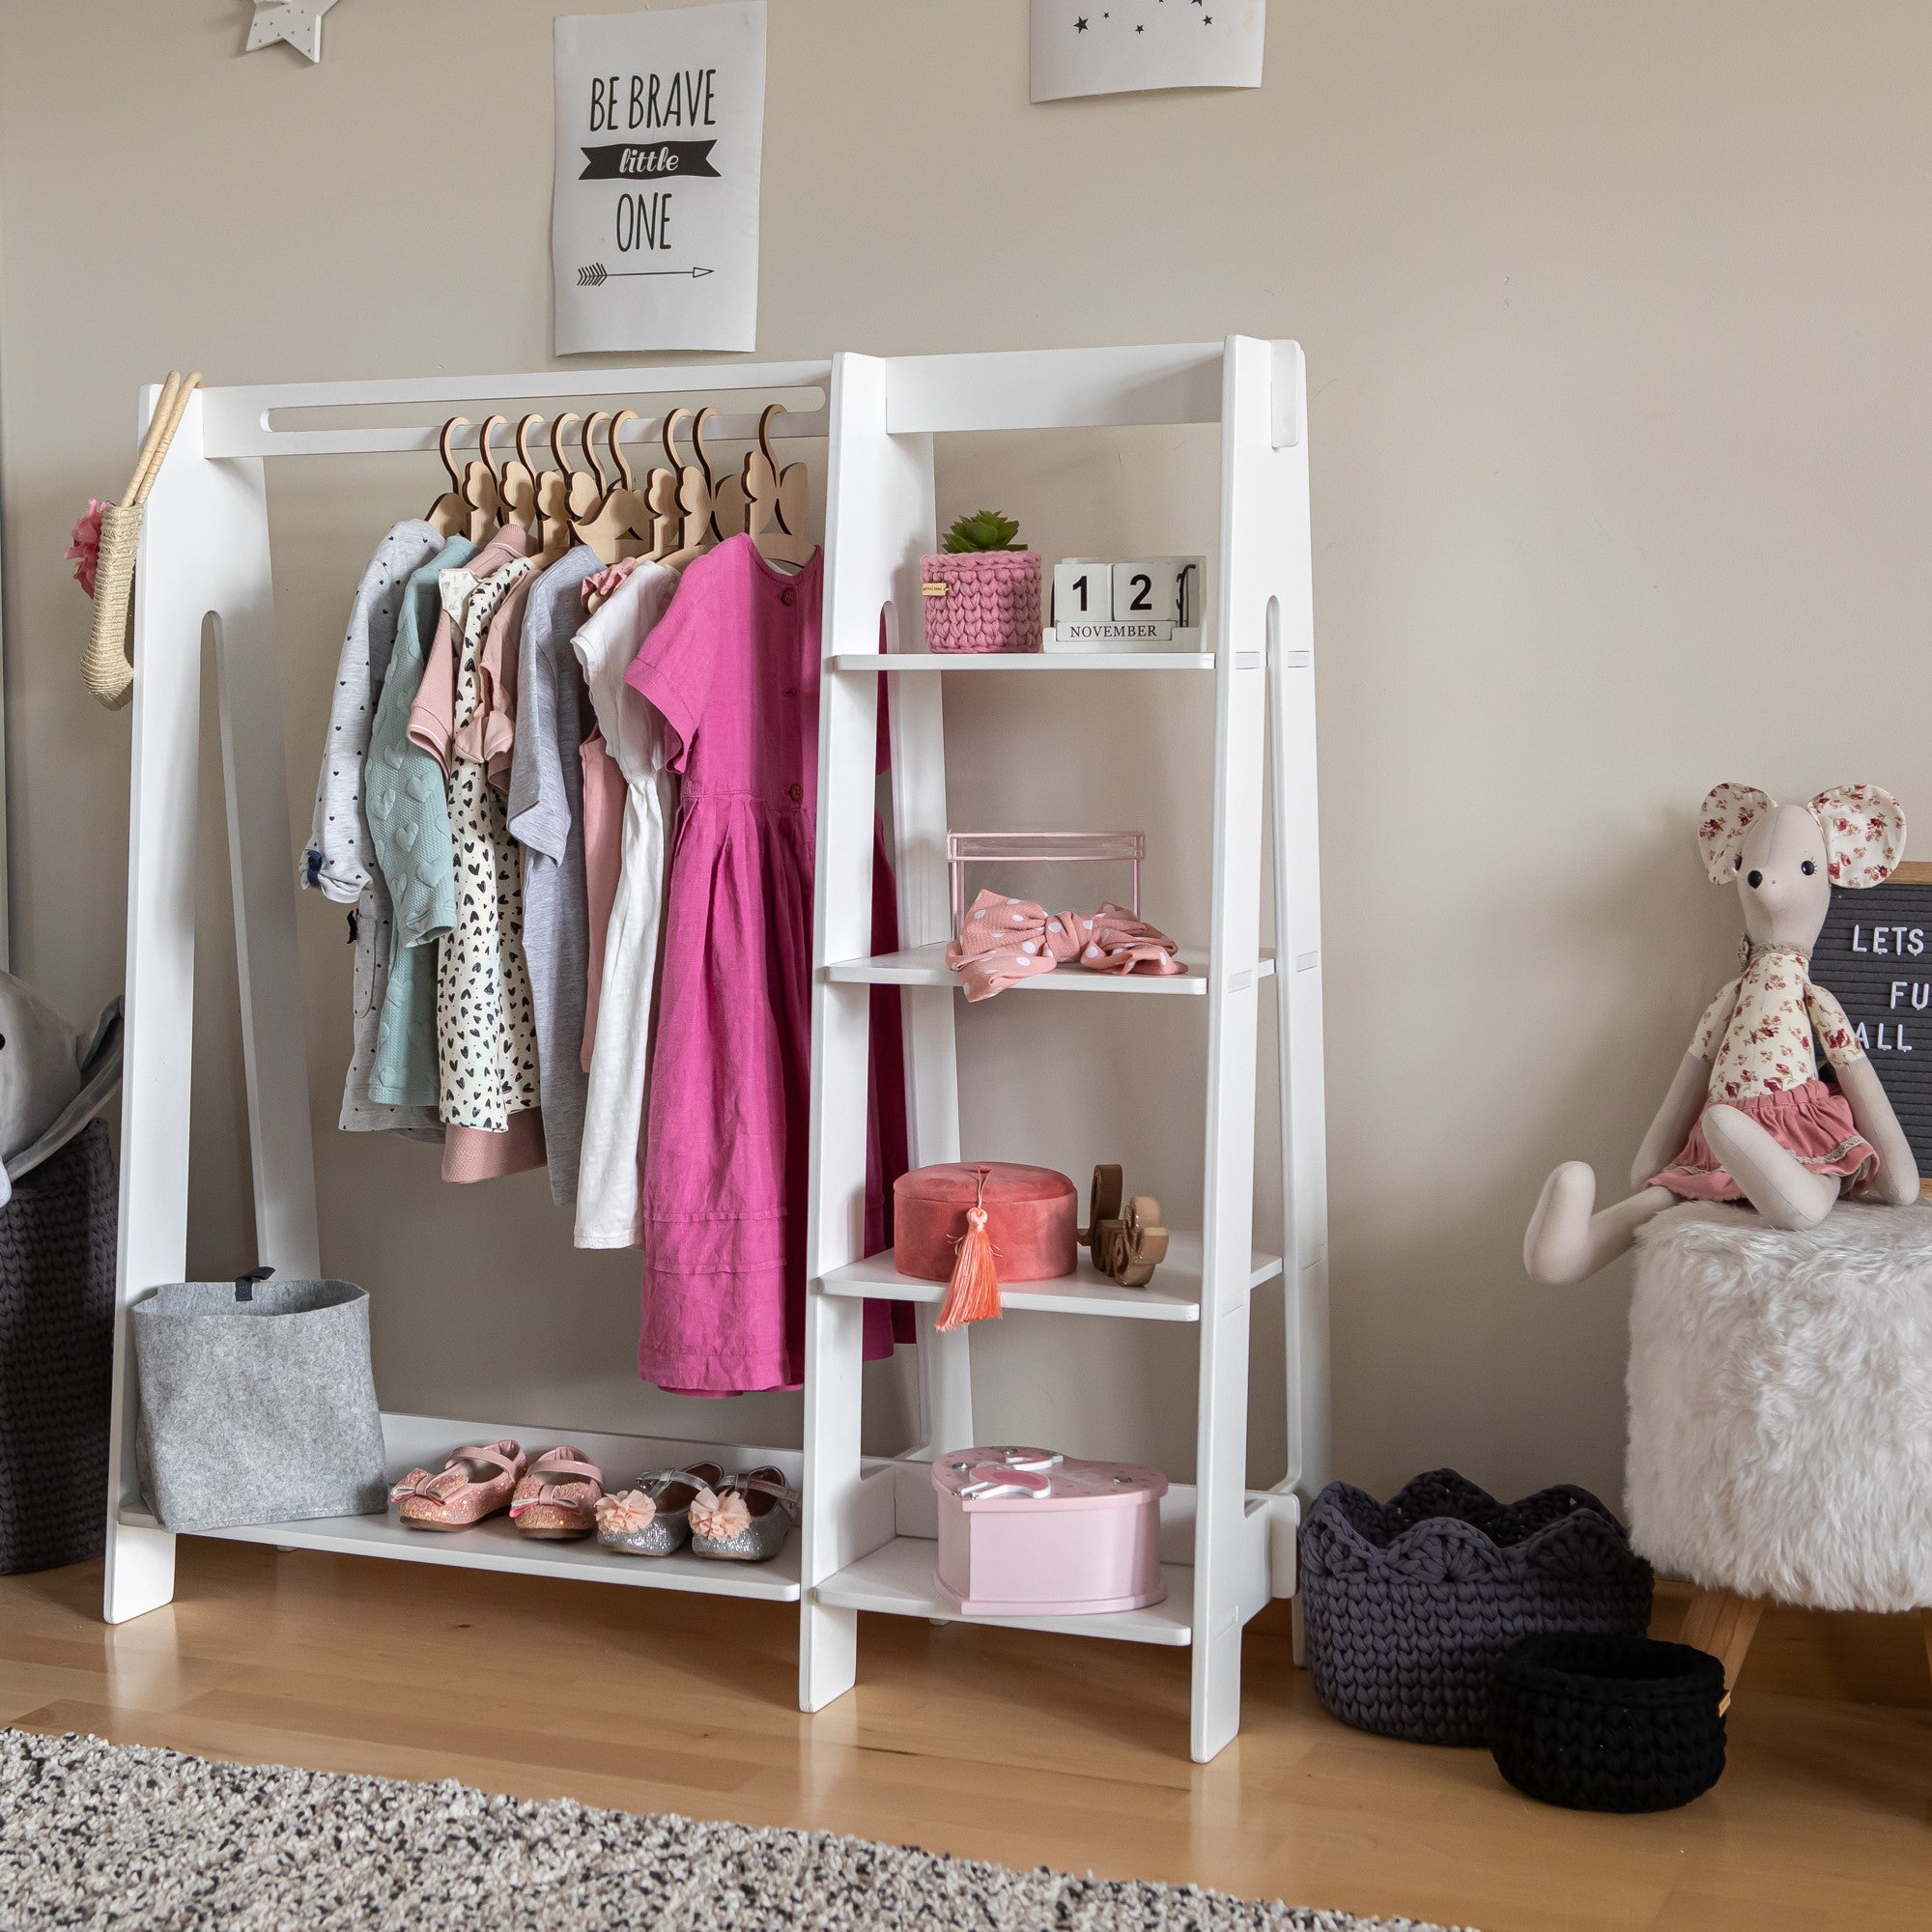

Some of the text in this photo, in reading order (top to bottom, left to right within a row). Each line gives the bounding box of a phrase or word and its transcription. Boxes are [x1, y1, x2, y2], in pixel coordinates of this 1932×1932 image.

[589, 69, 717, 132] BE BRAVE
[618, 146, 679, 174] little
[616, 191, 672, 253] ONE
[1069, 625, 1157, 638] NOVEMBER
[1852, 923, 1924, 956] LETS
[1855, 1020, 1913, 1053] ALL
